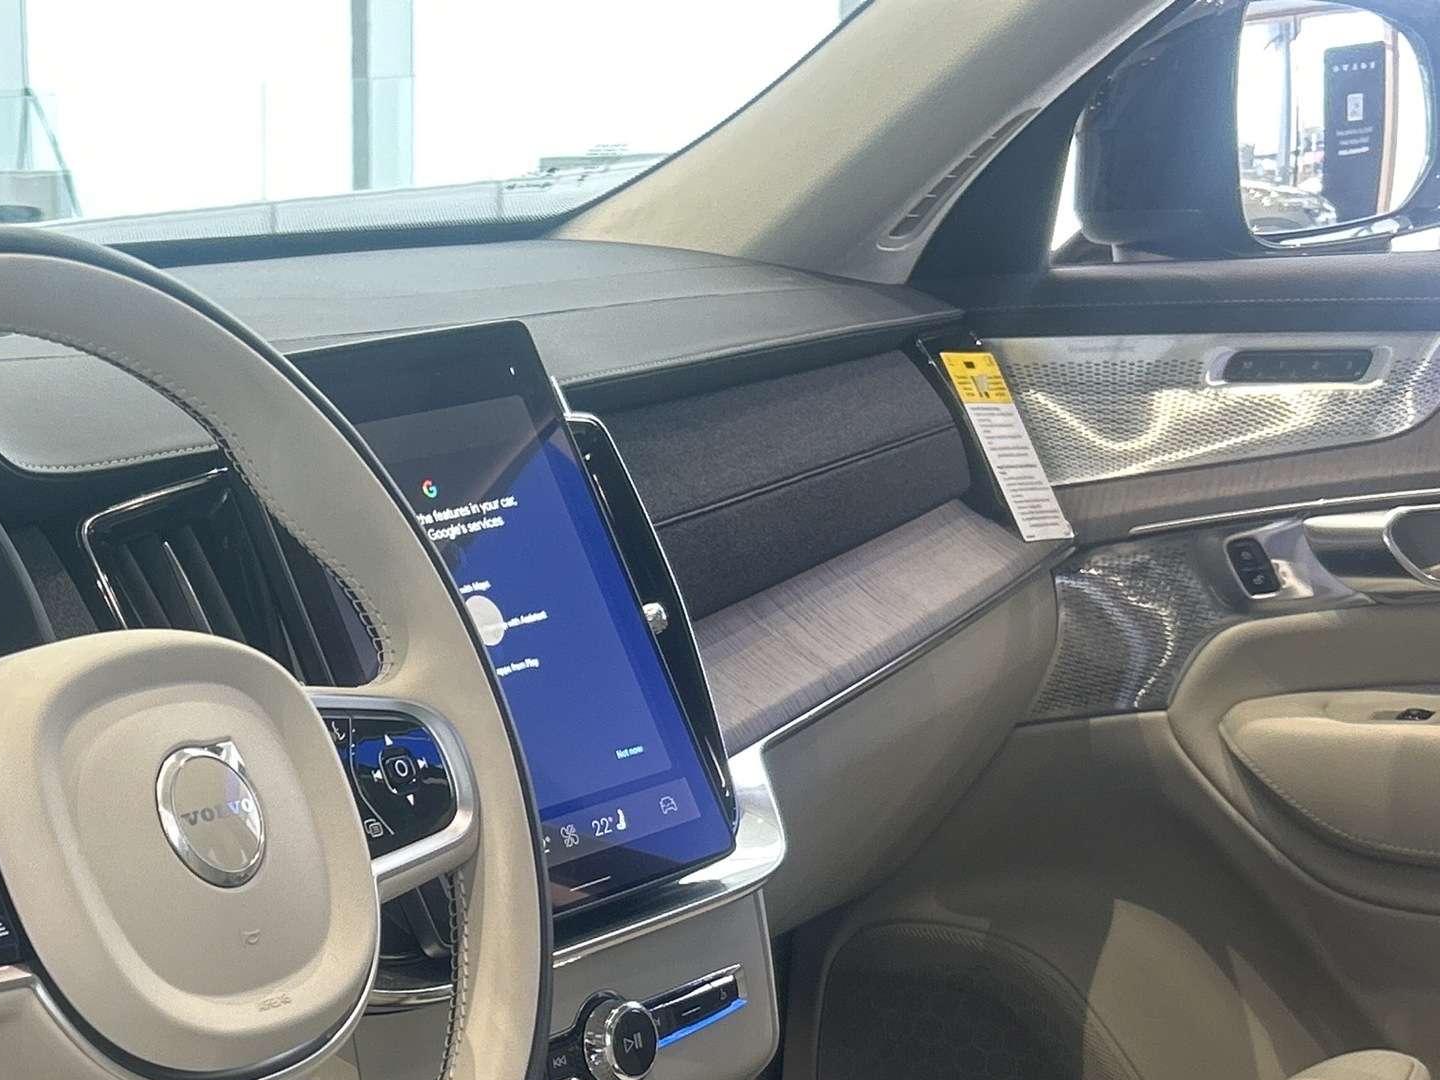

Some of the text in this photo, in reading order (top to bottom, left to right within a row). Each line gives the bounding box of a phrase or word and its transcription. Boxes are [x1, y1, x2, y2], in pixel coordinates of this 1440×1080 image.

[432, 505, 471, 522] features
[468, 502, 481, 514] in
[479, 499, 500, 514] your
[428, 516, 505, 540] Google's services
[180, 798, 255, 826] VOLVO
